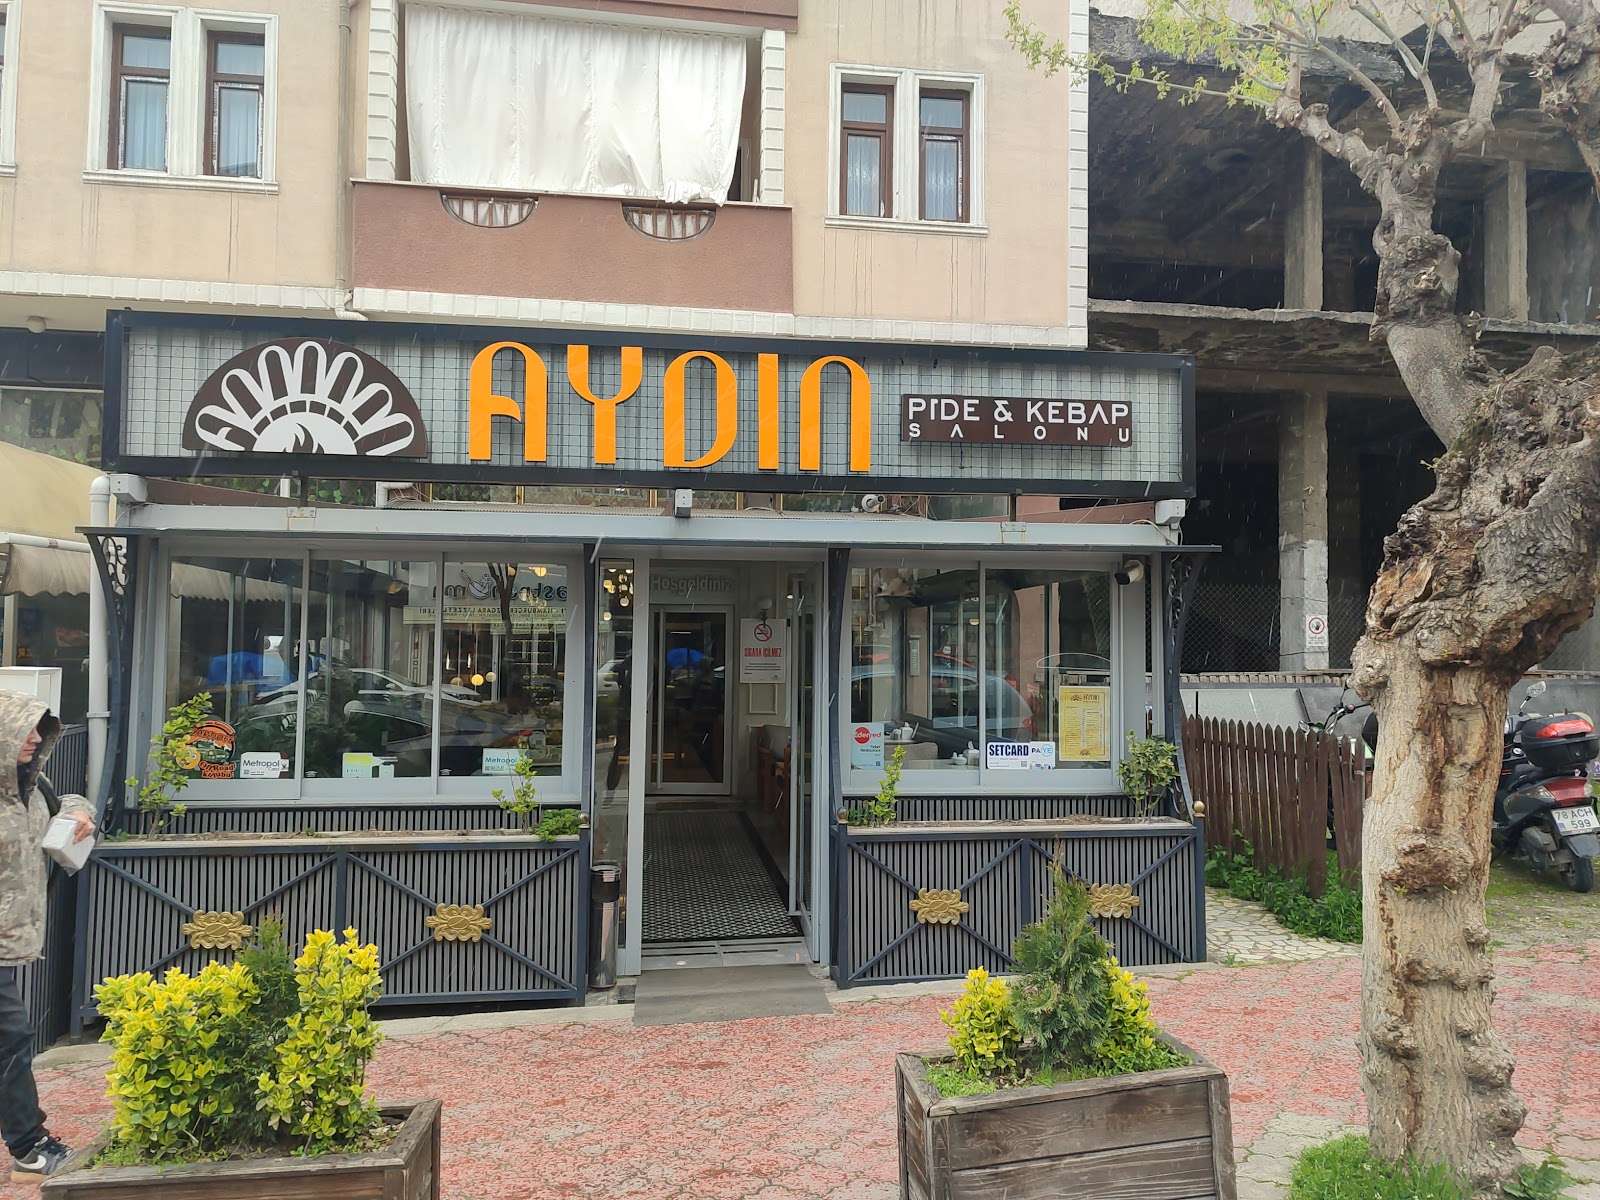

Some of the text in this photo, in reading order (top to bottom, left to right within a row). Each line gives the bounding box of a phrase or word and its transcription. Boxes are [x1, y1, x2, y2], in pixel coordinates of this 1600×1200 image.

[470, 343, 871, 472] AYDIN
[994, 401, 1014, 422] &
[1027, 402, 1129, 425] KEBAP
[908, 423, 1129, 442] SALONU
[854, 731, 881, 739] Edenred
[989, 744, 1029, 757] SETCARD
[242, 759, 280, 769] Metropol
[485, 757, 518, 765] Metropol
[1554, 808, 1593, 820] 78 ACH
[1570, 819, 1592, 829] 599
